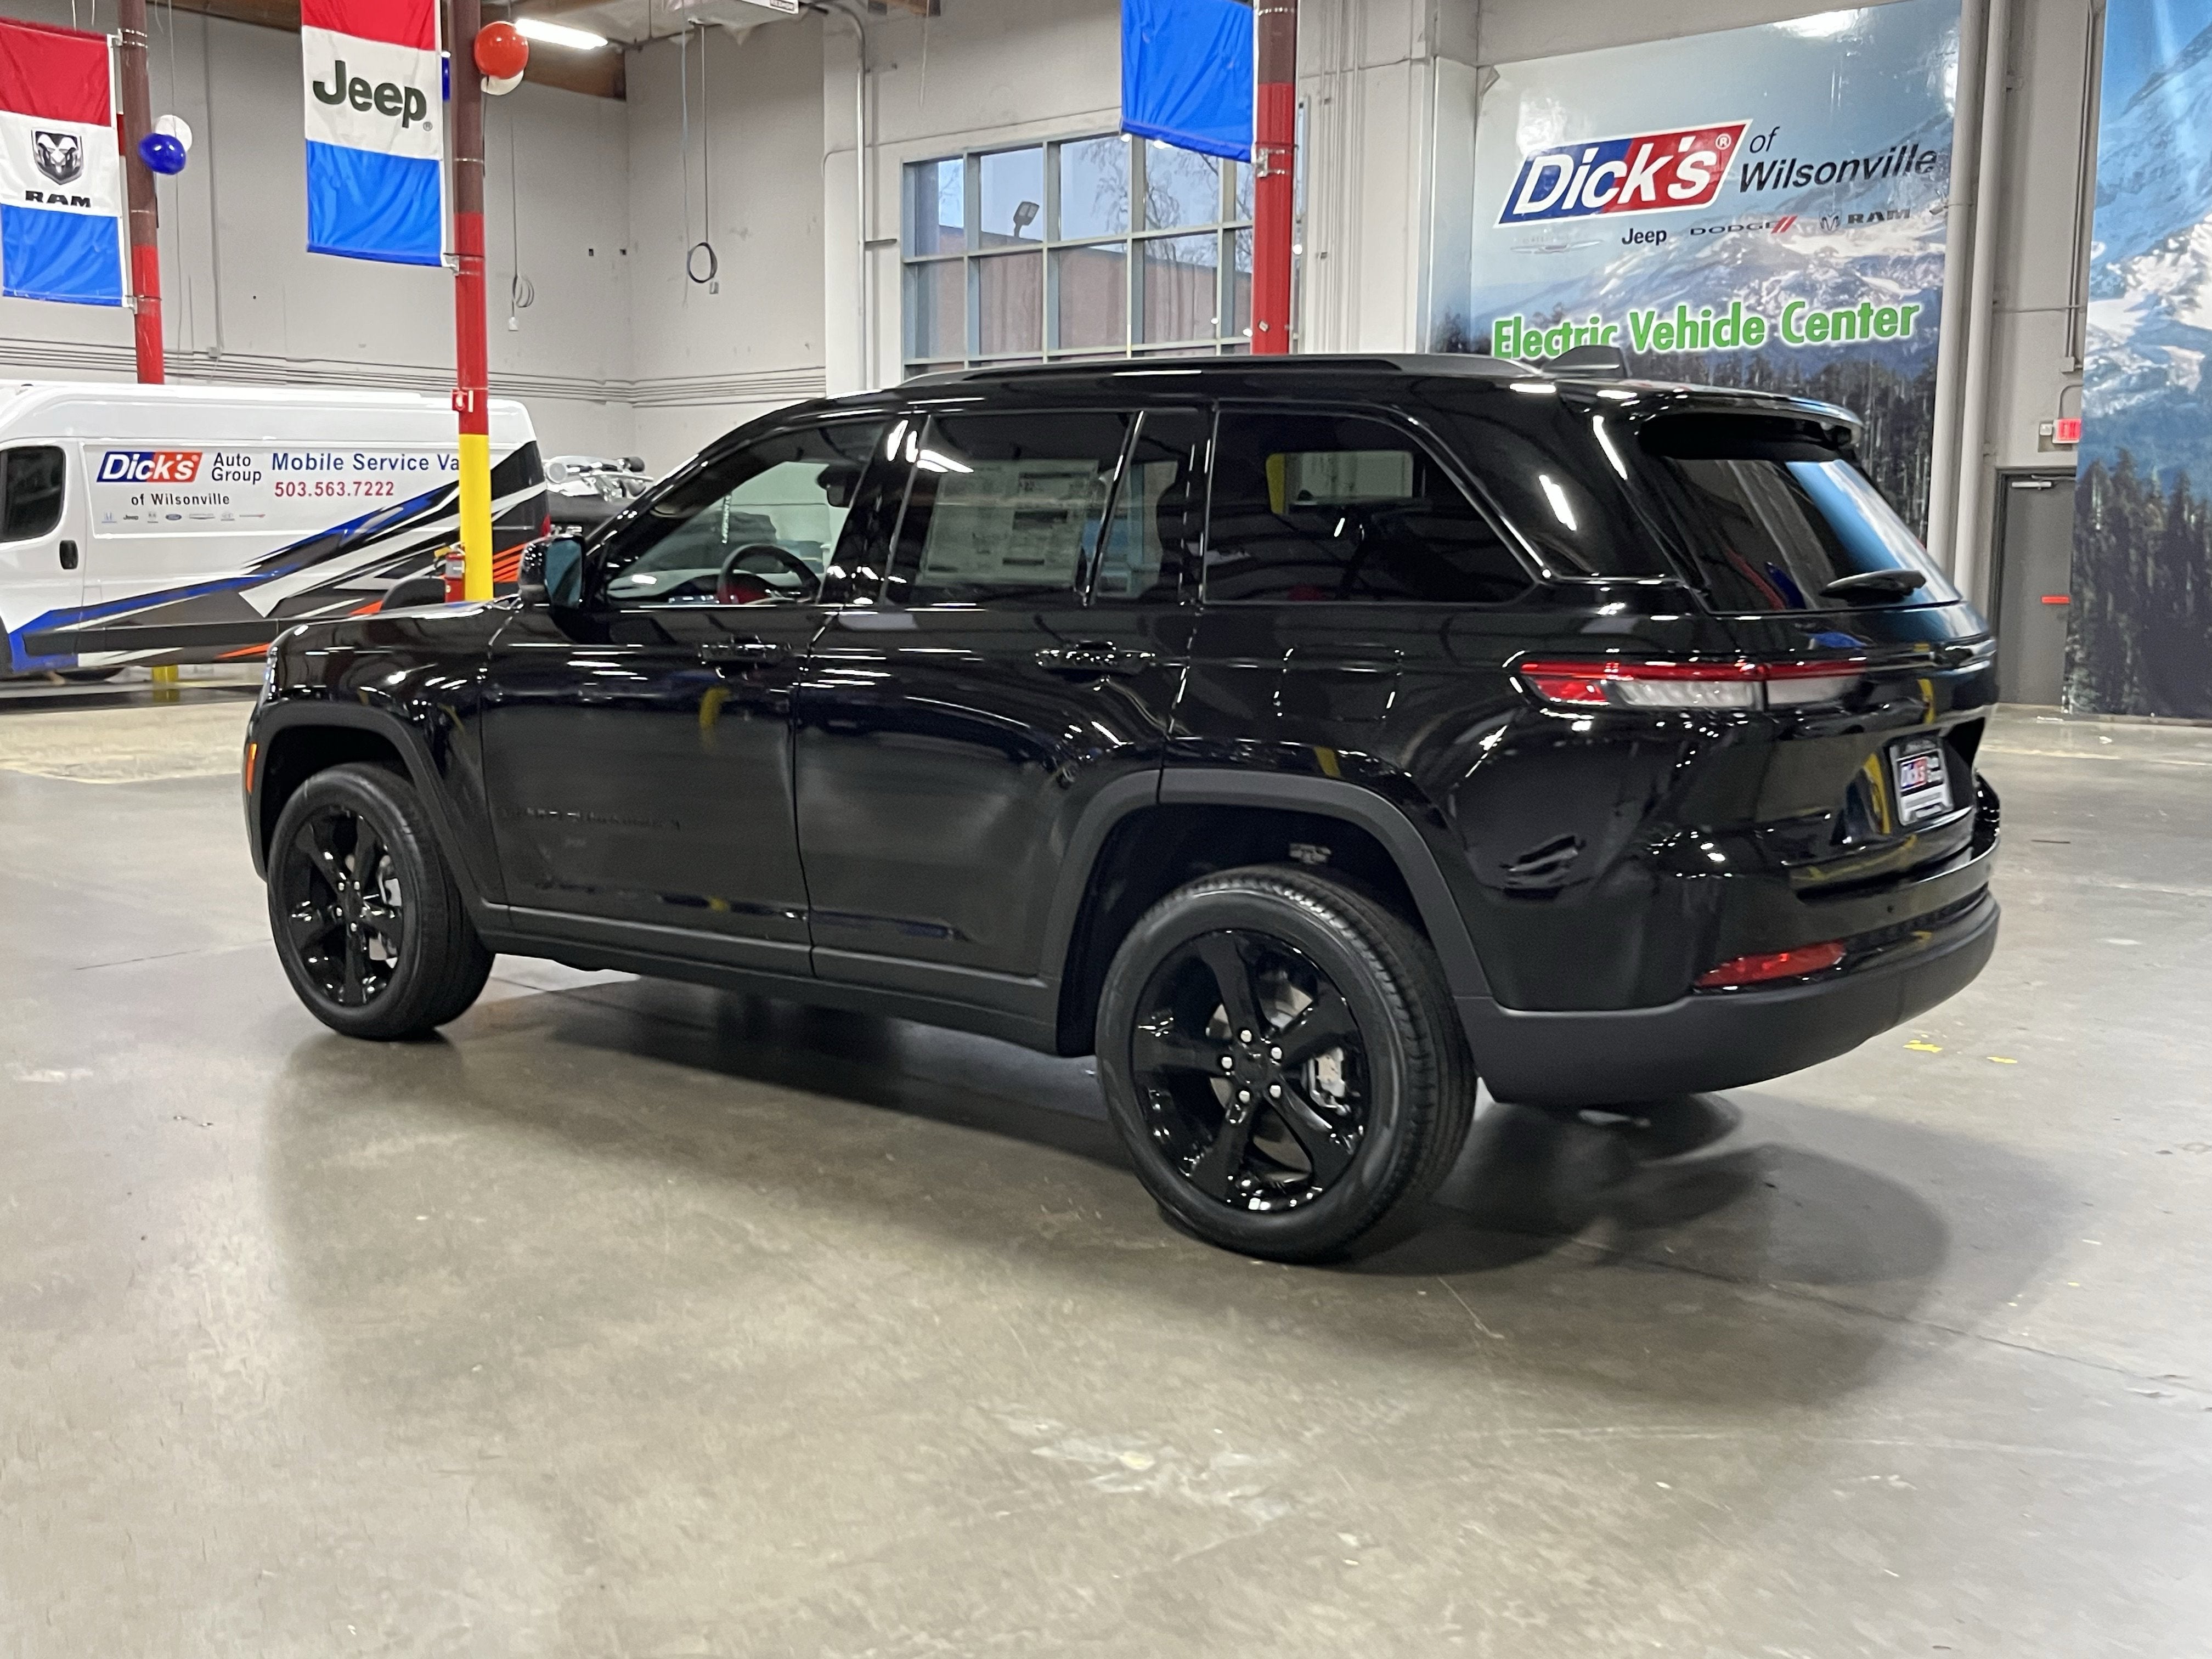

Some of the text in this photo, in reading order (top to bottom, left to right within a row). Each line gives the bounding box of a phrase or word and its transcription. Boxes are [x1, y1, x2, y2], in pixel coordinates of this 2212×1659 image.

[313, 60, 427, 129] Jeep
[1749, 126, 1780, 154] of
[1740, 143, 1937, 193] Wilsonville
[25, 190, 91, 208] RAM
[1848, 209, 1910, 224] RAM
[1622, 228, 1667, 246] Jeep
[1494, 301, 1919, 359] Electric Vehicle Center
[213, 453, 251, 466] Auto
[272, 453, 459, 471] Mobile Service Va
[212, 467, 262, 484] Group
[274, 482, 394, 497] 503.563.7222
[131, 493, 230, 505] of Wilsonville
